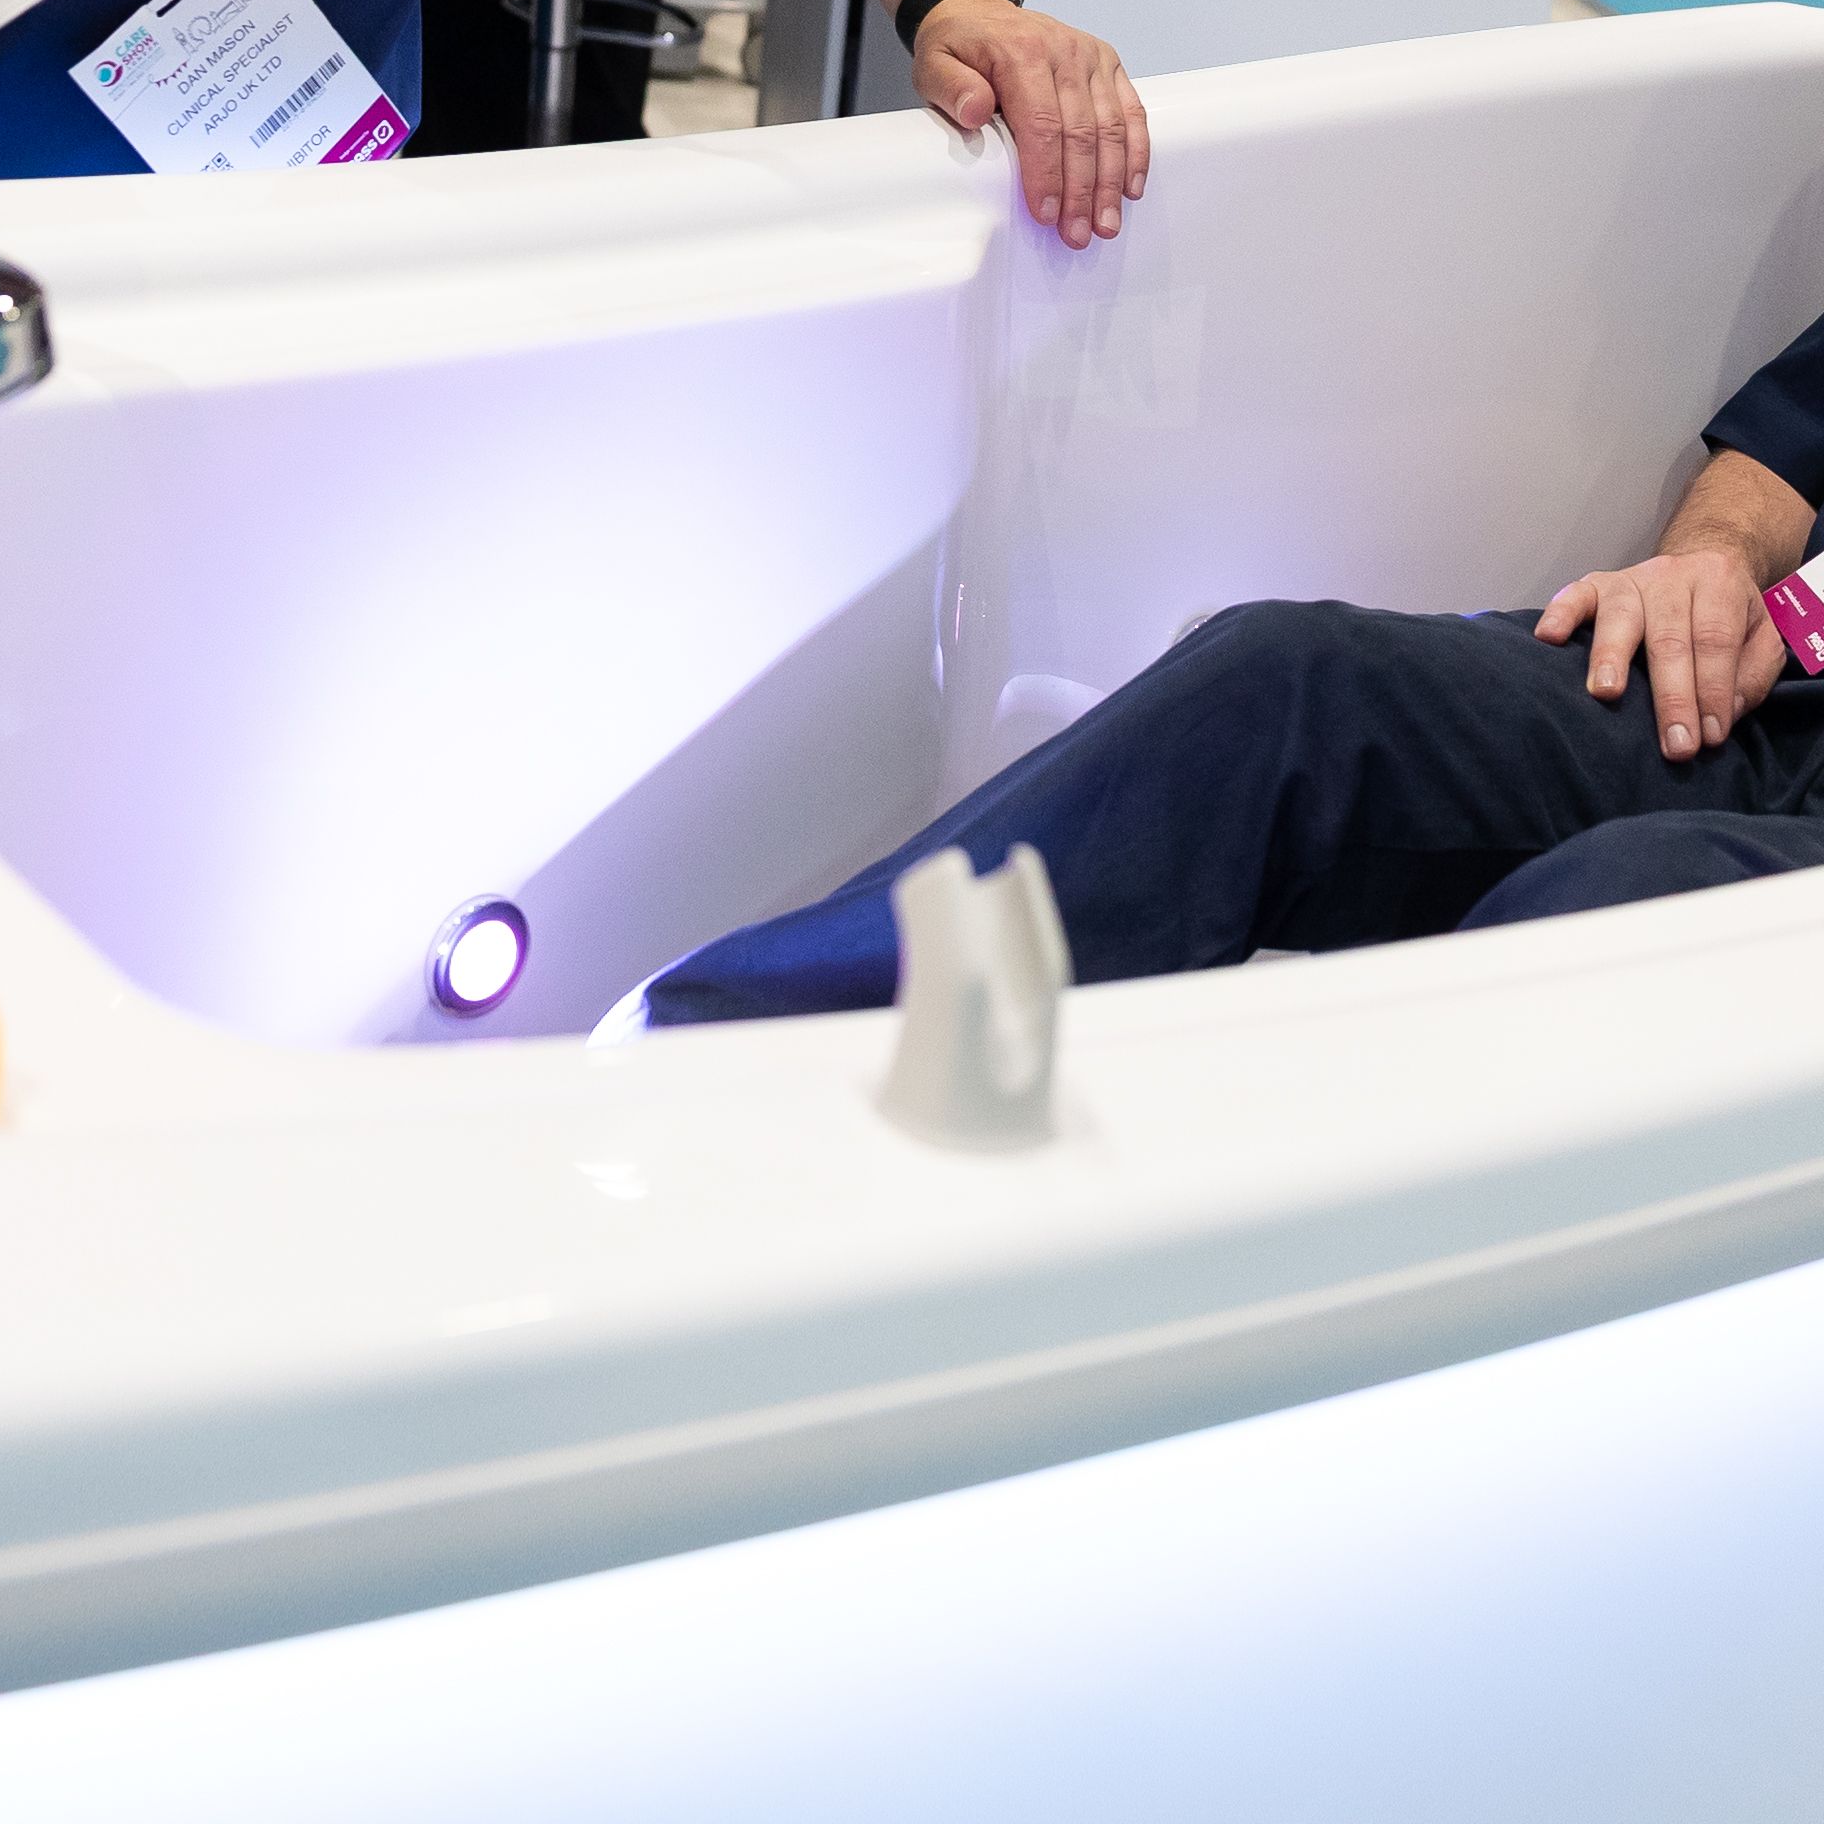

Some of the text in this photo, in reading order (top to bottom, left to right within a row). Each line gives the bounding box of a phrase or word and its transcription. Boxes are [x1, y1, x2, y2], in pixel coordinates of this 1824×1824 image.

[115, 26, 150, 57] CARE
[122, 34, 155, 65] SHOW
[167, 85, 225, 136] CLINICAL
[223, 13, 295, 83] SPECIALIST
[177, 64, 207, 95] DAN
[208, 19, 256, 65] MASON
[204, 54, 283, 136] ARJO UK LTD
